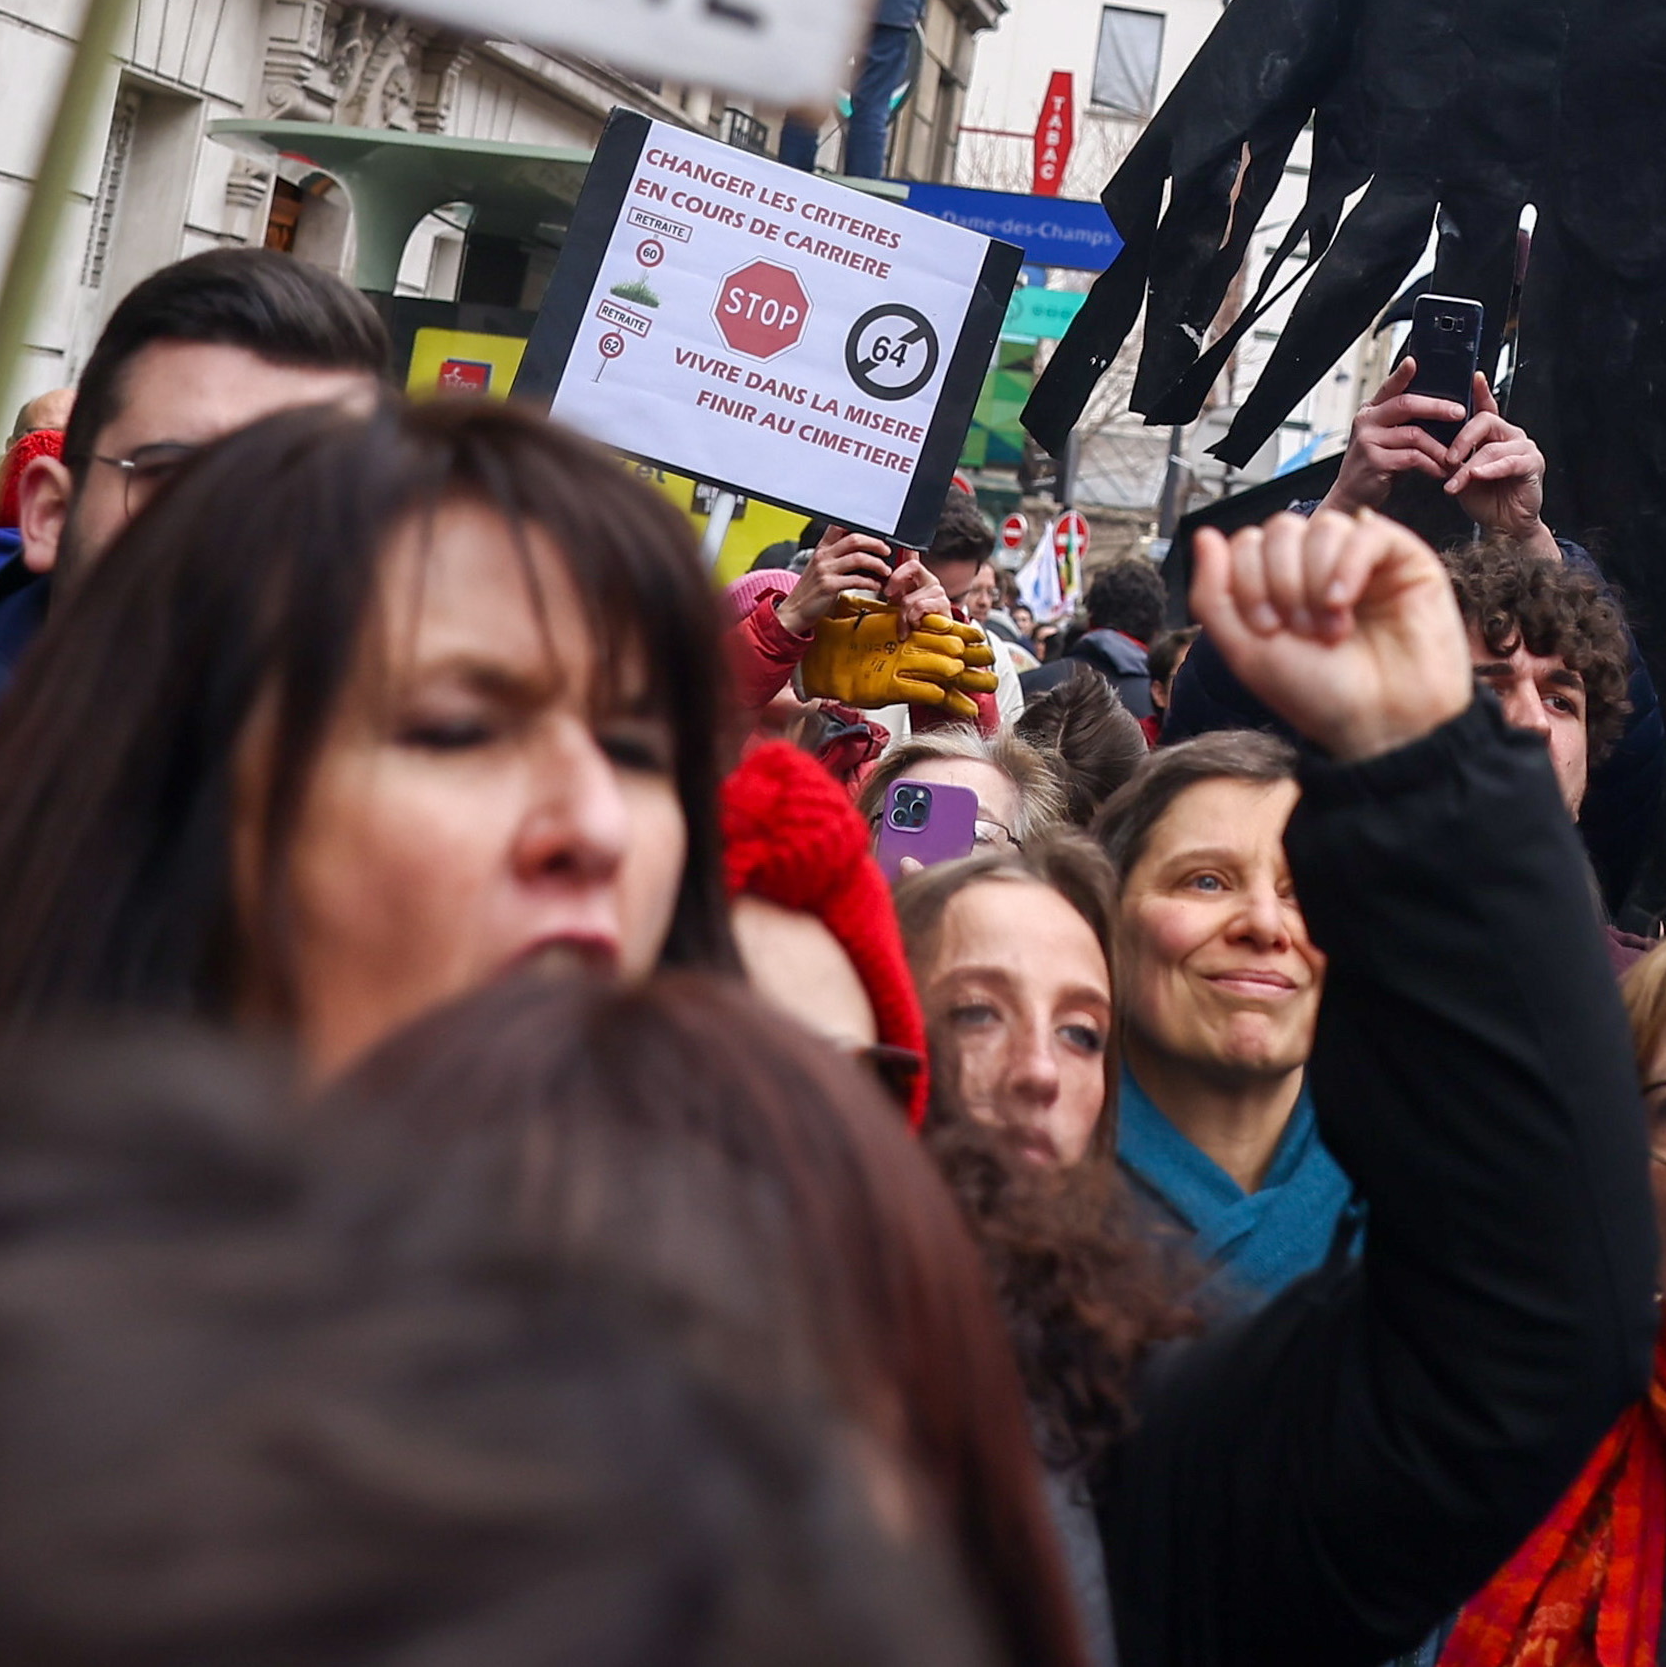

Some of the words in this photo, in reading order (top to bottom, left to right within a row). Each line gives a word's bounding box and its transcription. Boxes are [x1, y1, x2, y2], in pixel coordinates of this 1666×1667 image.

[1039, 95, 1066, 181] TABAC
[646, 148, 755, 200] CHANGER
[757, 186, 797, 213] LES
[800, 202, 902, 250] CRITERES
[634, 212, 685, 238] RETRAITE
[634, 178, 668, 204] EN
[671, 191, 746, 229] COURS
[748, 216, 782, 242] DE
[784, 230, 893, 280] CARRIERE
[642, 247, 658, 260] 60
[600, 305, 646, 332] RETRAITE
[724, 287, 799, 330] STOP
[603, 337, 620, 353] 62
[872, 336, 907, 368] 64
[675, 347, 743, 384] VIVRE
[744, 372, 808, 406] DANS
[810, 393, 839, 417] LA
[843, 405, 924, 444] MISERE
[695, 390, 757, 423] FINIR
[758, 411, 796, 435] AU
[798, 424, 915, 474] CIMETIERE
